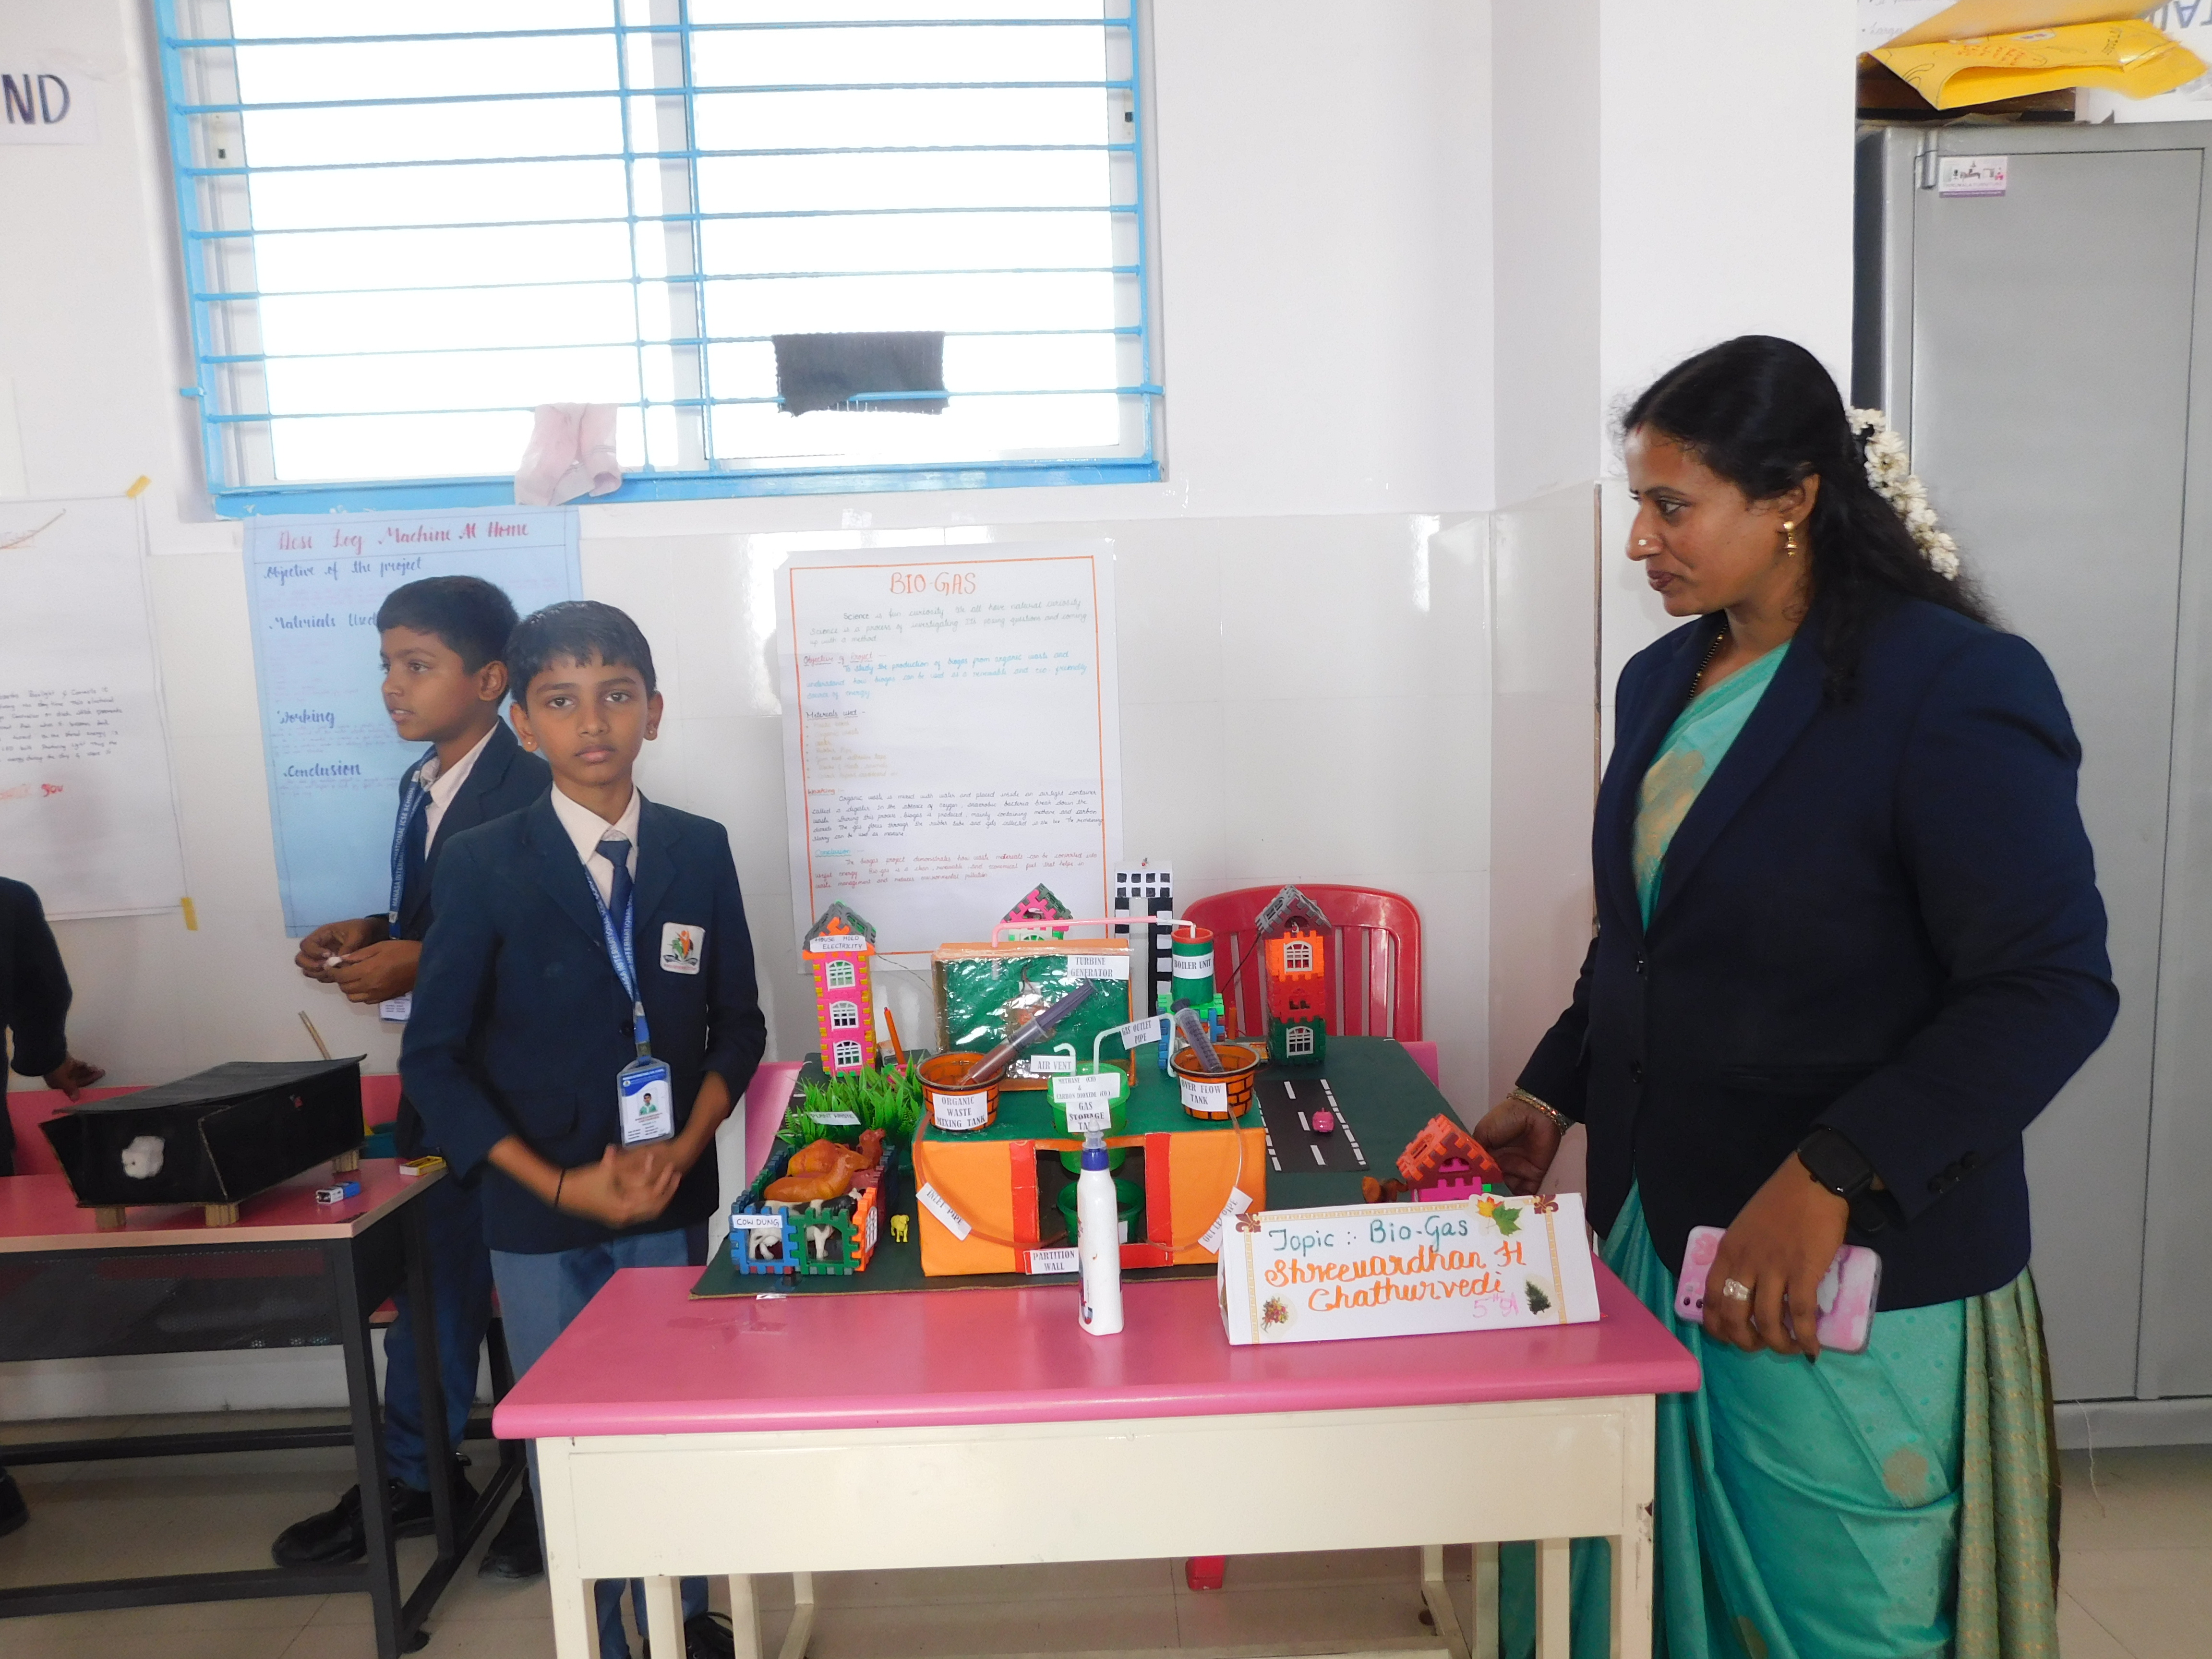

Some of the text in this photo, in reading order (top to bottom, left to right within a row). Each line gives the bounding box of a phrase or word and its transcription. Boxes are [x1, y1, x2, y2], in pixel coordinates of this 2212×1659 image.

[378, 525, 451, 544] Machine
[488, 521, 529, 538] Home
[351, 560, 371, 573] the
[380, 556, 421, 577] project
[971, 604, 982, 613] all
[988, 602, 1005, 612] have
[1010, 601, 1042, 610] natural
[269, 613, 336, 629] Materials
[809, 628, 838, 636] Science
[1044, 613, 1059, 621] and
[851, 634, 877, 643] method
[854, 664, 874, 675] study
[891, 660, 929, 671] production
[276, 709, 335, 729] Working
[283, 759, 361, 777] Conclusion
[975, 791, 996, 800] placed
[1075, 957, 1106, 966] TURBINE
[1174, 958, 1211, 970] BOILER UNIT
[1070, 968, 1113, 977] GENERATOR
[1121, 1020, 1152, 1036] GAS OUTLET
[1134, 1033, 1147, 1044] PIPE
[1037, 1061, 1072, 1070] AIR VENT
[1181, 1080, 1221, 1094] OVER FLOW
[941, 1096, 974, 1106] ORGANIC
[1190, 1094, 1208, 1105] TANK
[947, 1108, 972, 1117] WASTE
[1079, 1102, 1093, 1111] GAS
[937, 1115, 986, 1128] MIXING TANK
[1069, 1112, 1105, 1121] STORAGE
[926, 1189, 962, 1225] INLET PIPE
[1269, 1215, 1468, 1257] Topic Bio-Gas
[1033, 1250, 1075, 1261] PARTITION
[1044, 1262, 1065, 1271] WALL
[1308, 1271, 1505, 1311] Chathurvedi
